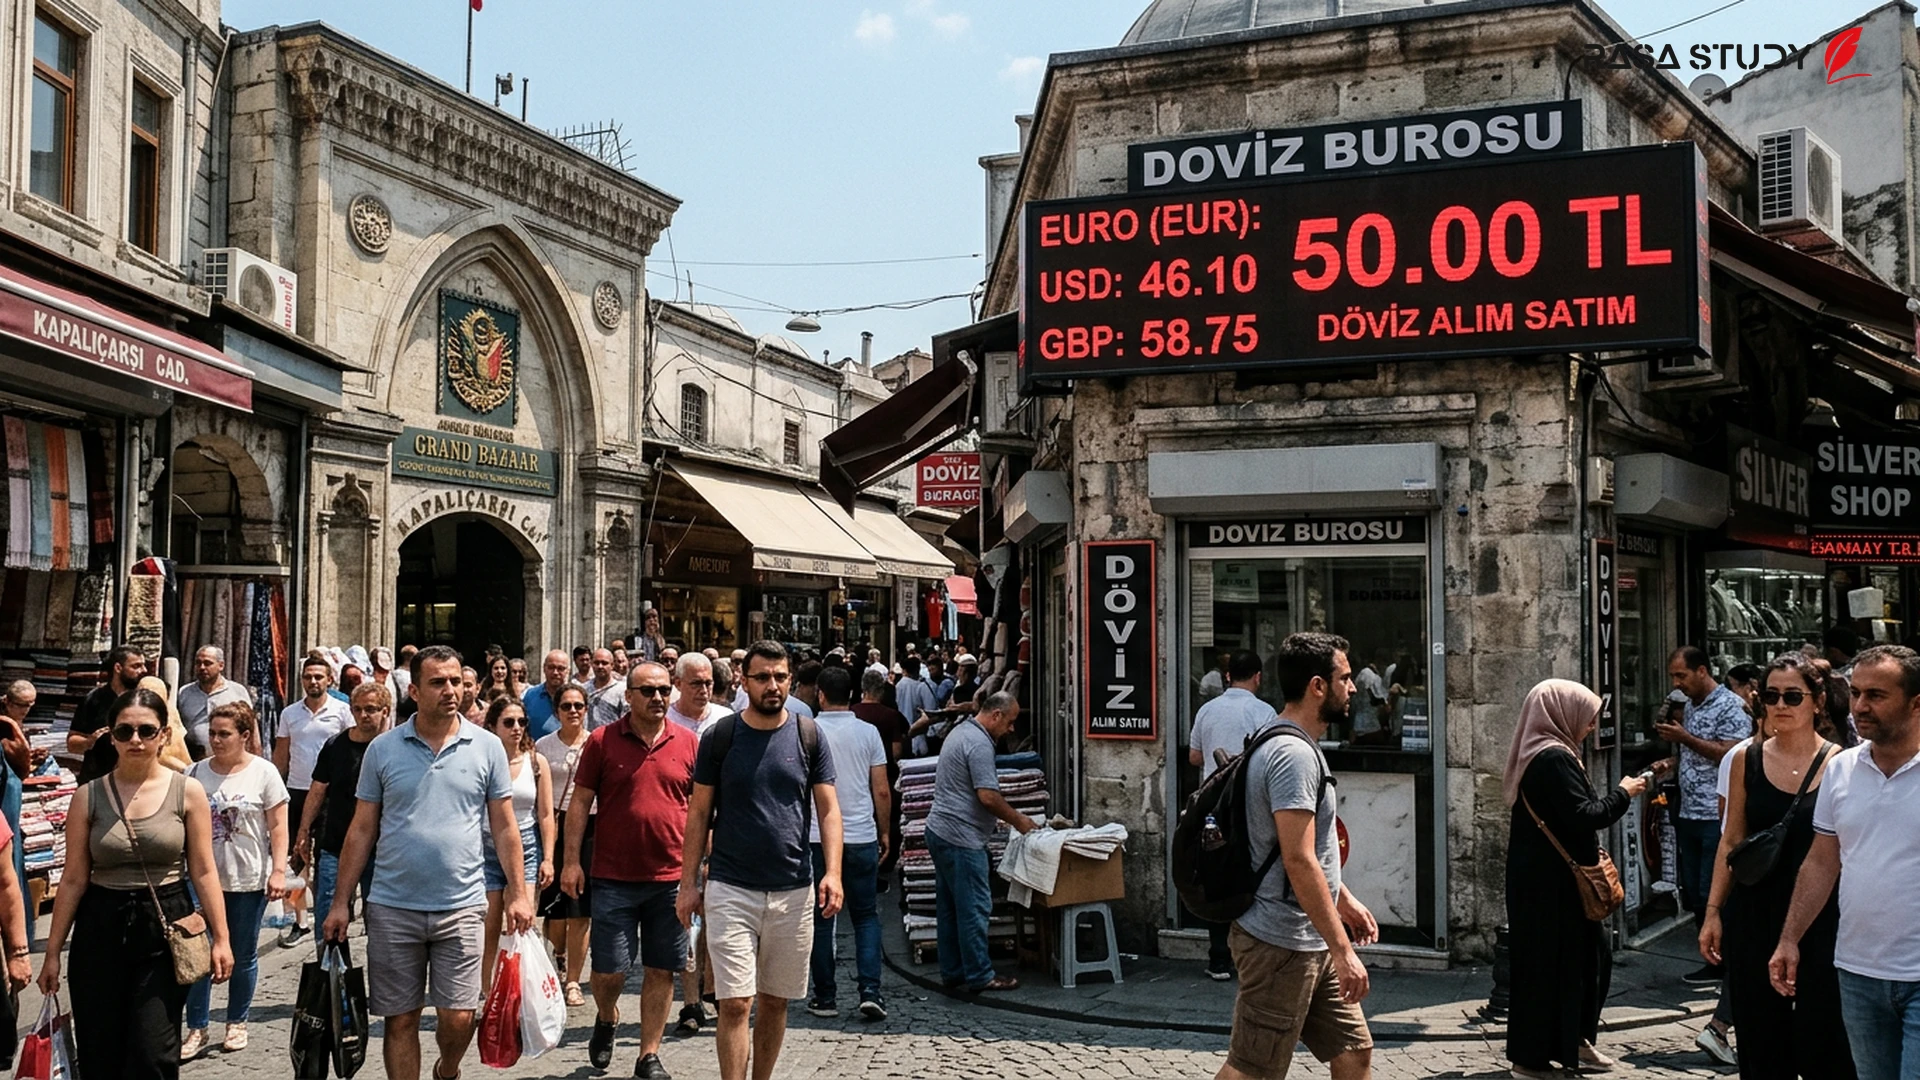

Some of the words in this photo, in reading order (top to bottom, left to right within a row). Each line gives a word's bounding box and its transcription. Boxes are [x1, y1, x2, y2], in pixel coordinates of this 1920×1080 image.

[1143, 131, 1304, 187] DOVİZ
[1324, 110, 1563, 170] BUROSU
[1041, 209, 1139, 247] EURO
[1150, 199, 1261, 246] (EUR):
[1292, 200, 1541, 292] 50.00
[1568, 194, 1672, 269] TL
[1040, 268, 1122, 303] USD:
[1139, 254, 1258, 299] 46.10
[1040, 325, 1124, 360] GBP:
[1140, 314, 1259, 358] 58.75
[1318, 303, 1420, 342] DÖVİZ
[1428, 303, 1513, 336] ALIM
[1524, 295, 1636, 330] SATIM
[33, 310, 144, 371] KAPALIÇARŞI
[156, 354, 189, 385] CAD.
[415, 434, 472, 463] GRAND
[477, 443, 539, 472] BAZAAR
[923, 462, 980, 481] DOVİZ
[1817, 435, 1920, 476] SİLVER
[1739, 439, 1809, 518] SİLVER
[1830, 485, 1911, 517] SHOP
[1209, 523, 1286, 544] DOVIZ
[1294, 520, 1404, 541] BUROSU
[1104, 555, 1137, 710] DÖVİZ
